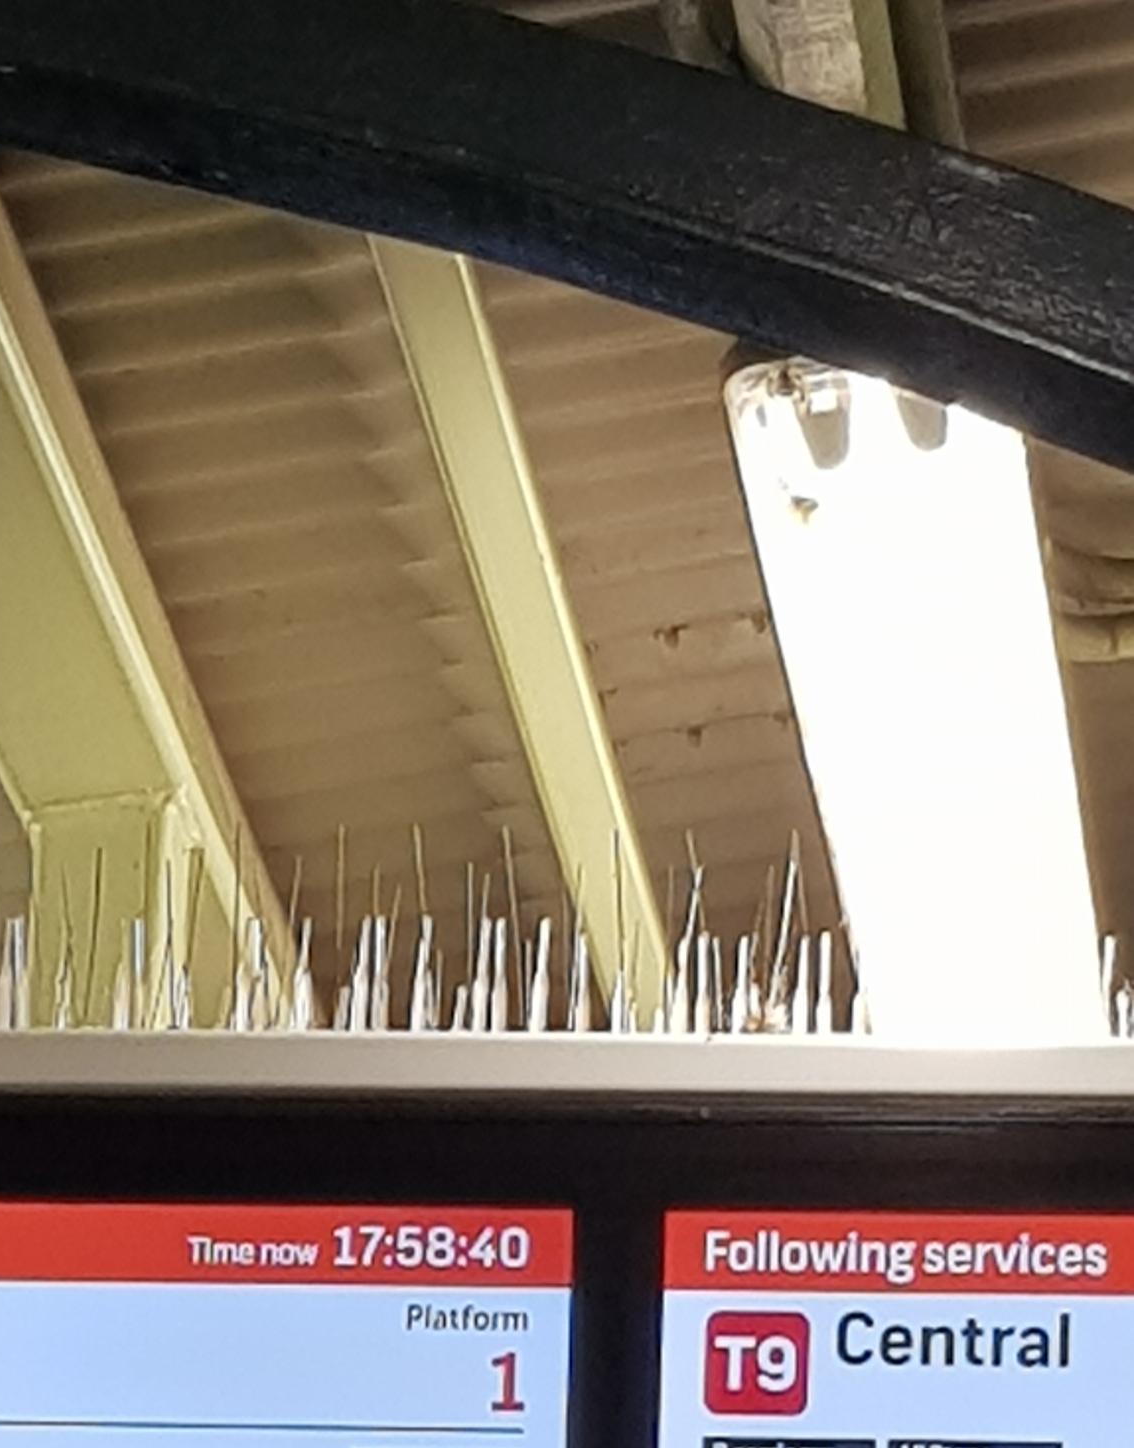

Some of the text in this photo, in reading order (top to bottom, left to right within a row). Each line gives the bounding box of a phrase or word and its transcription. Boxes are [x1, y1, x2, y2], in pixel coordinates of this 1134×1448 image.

[187, 1236, 318, 1266] Time now
[333, 1225, 529, 1268] 17:58:40
[705, 1230, 1108, 1284] Following services
[407, 1304, 528, 1331] Platform
[837, 1311, 1070, 1368] Central
[491, 1352, 525, 1412] 1
[714, 1335, 797, 1392] T9
